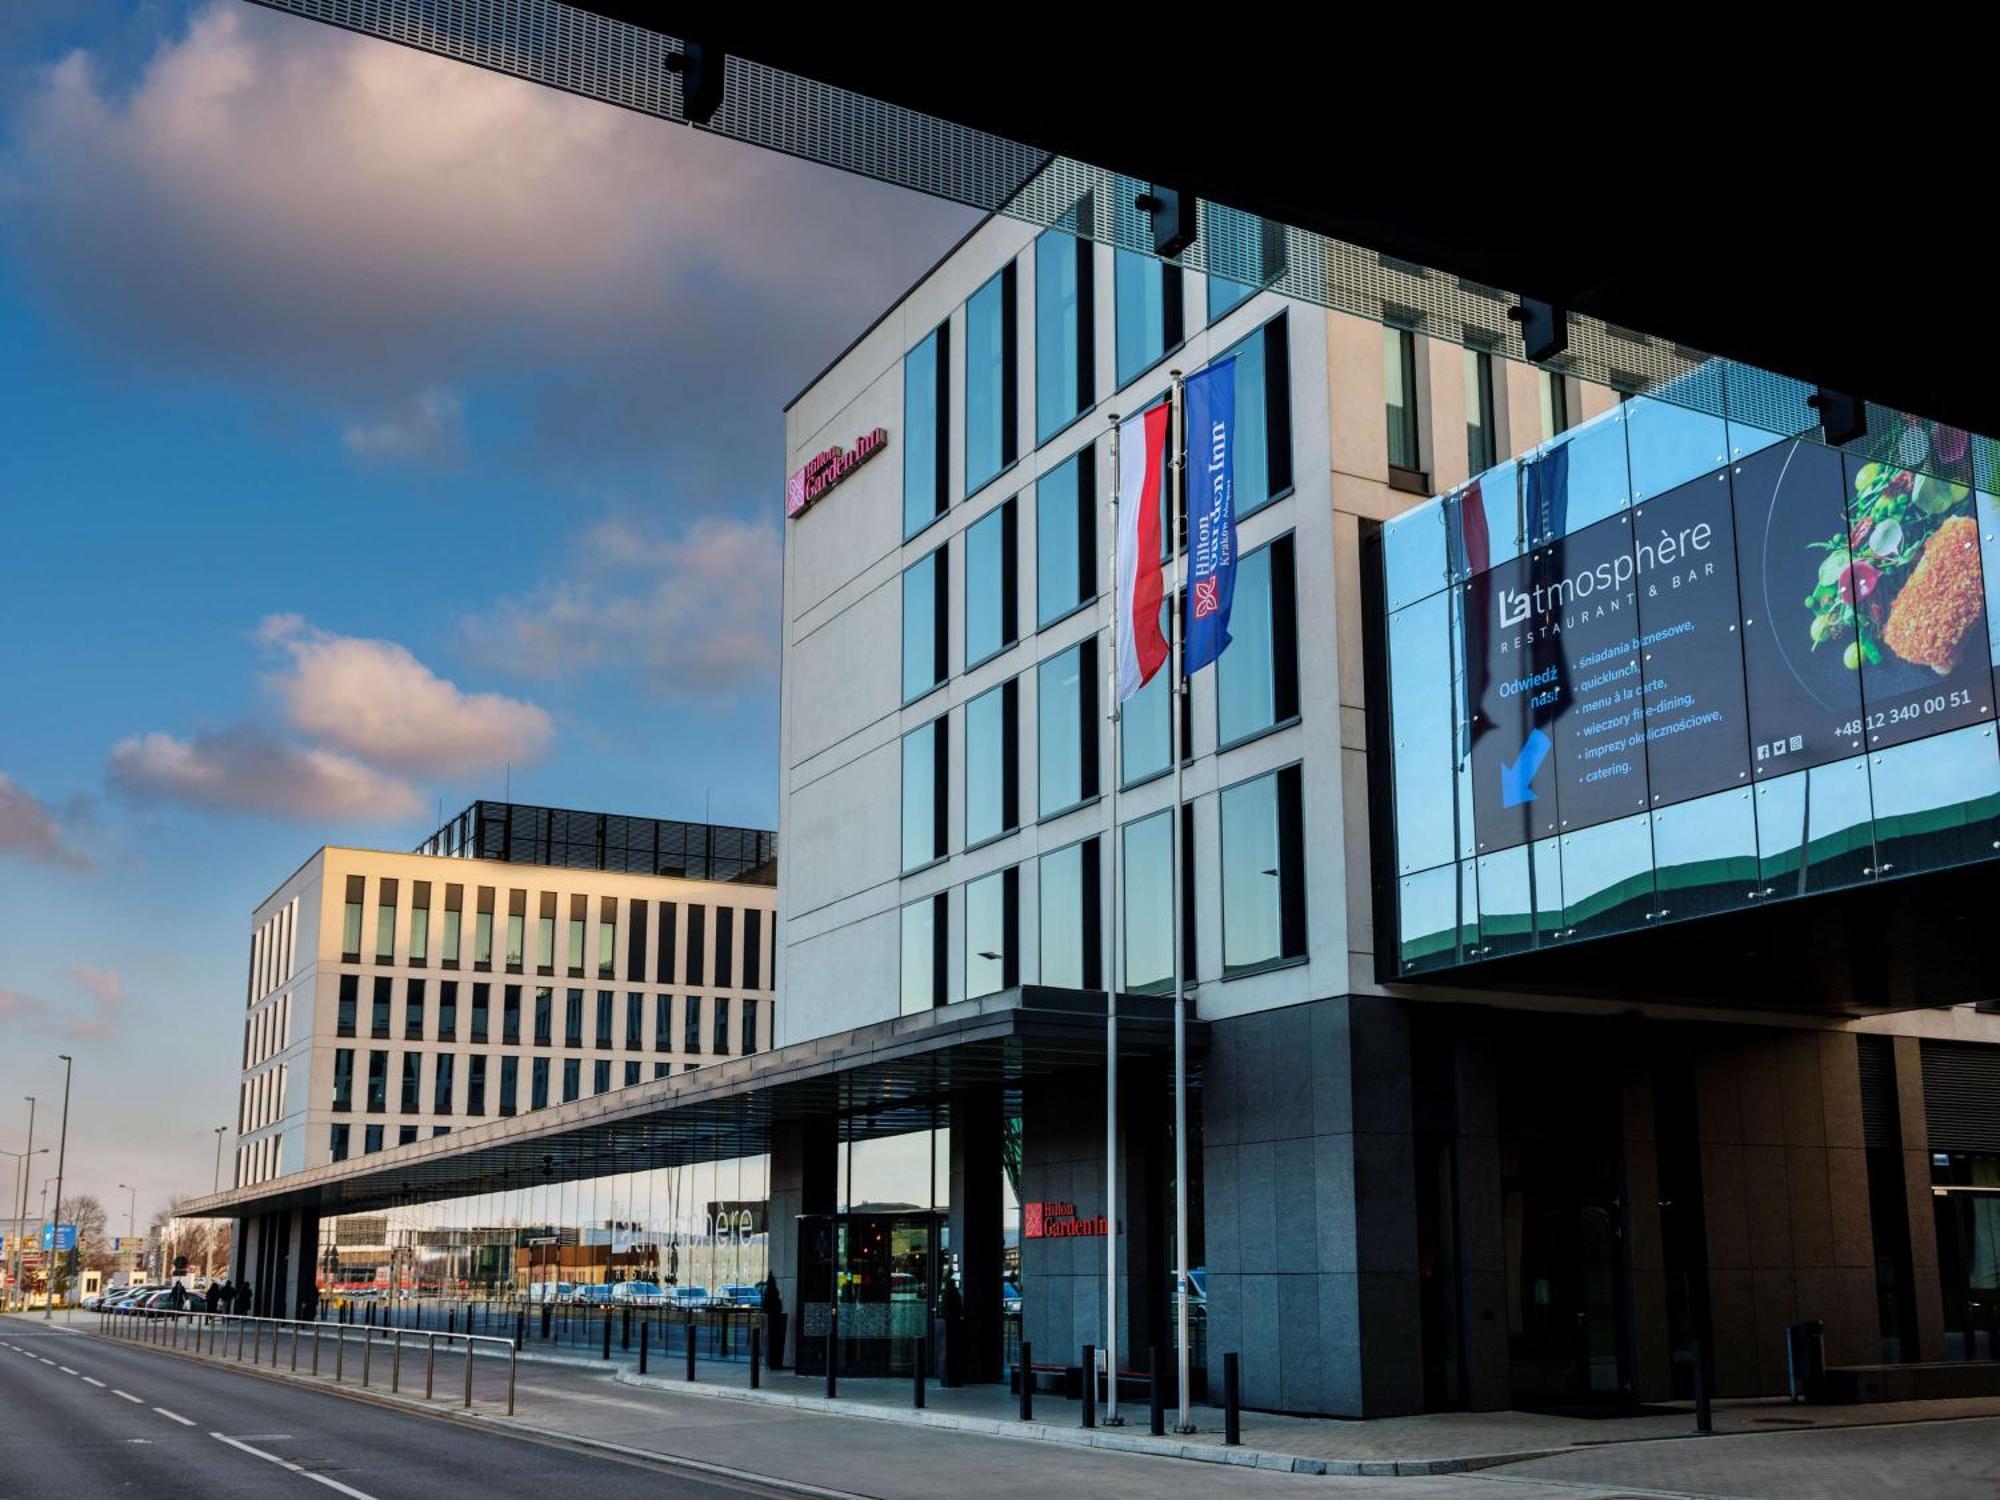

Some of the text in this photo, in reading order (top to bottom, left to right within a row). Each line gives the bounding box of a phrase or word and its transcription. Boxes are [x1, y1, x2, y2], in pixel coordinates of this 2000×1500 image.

[806, 446, 837, 478] Hilton
[1208, 421, 1226, 472] Inn
[805, 428, 882, 500] Garden Inn
[1196, 516, 1210, 577] Hilton
[1499, 523, 1712, 629] L'atmosphère
[1501, 563, 1715, 653] RESTAURANT & BAR
[1579, 621, 1695, 668] śniadania bznesowe,
[1500, 666, 1558, 697] Odwiedź
[1582, 695, 1612, 714] menu
[1614, 690, 1621, 703] à
[1623, 688, 1633, 700] la
[1834, 689, 1972, 738] +48 12 340 00 51
[1583, 710, 1630, 737] wieczory
[1584, 738, 1626, 761] imprezy
[1586, 762, 1632, 784] catering.
[1044, 1202, 1073, 1217] Hilton
[1044, 1216, 1091, 1236] Garden
